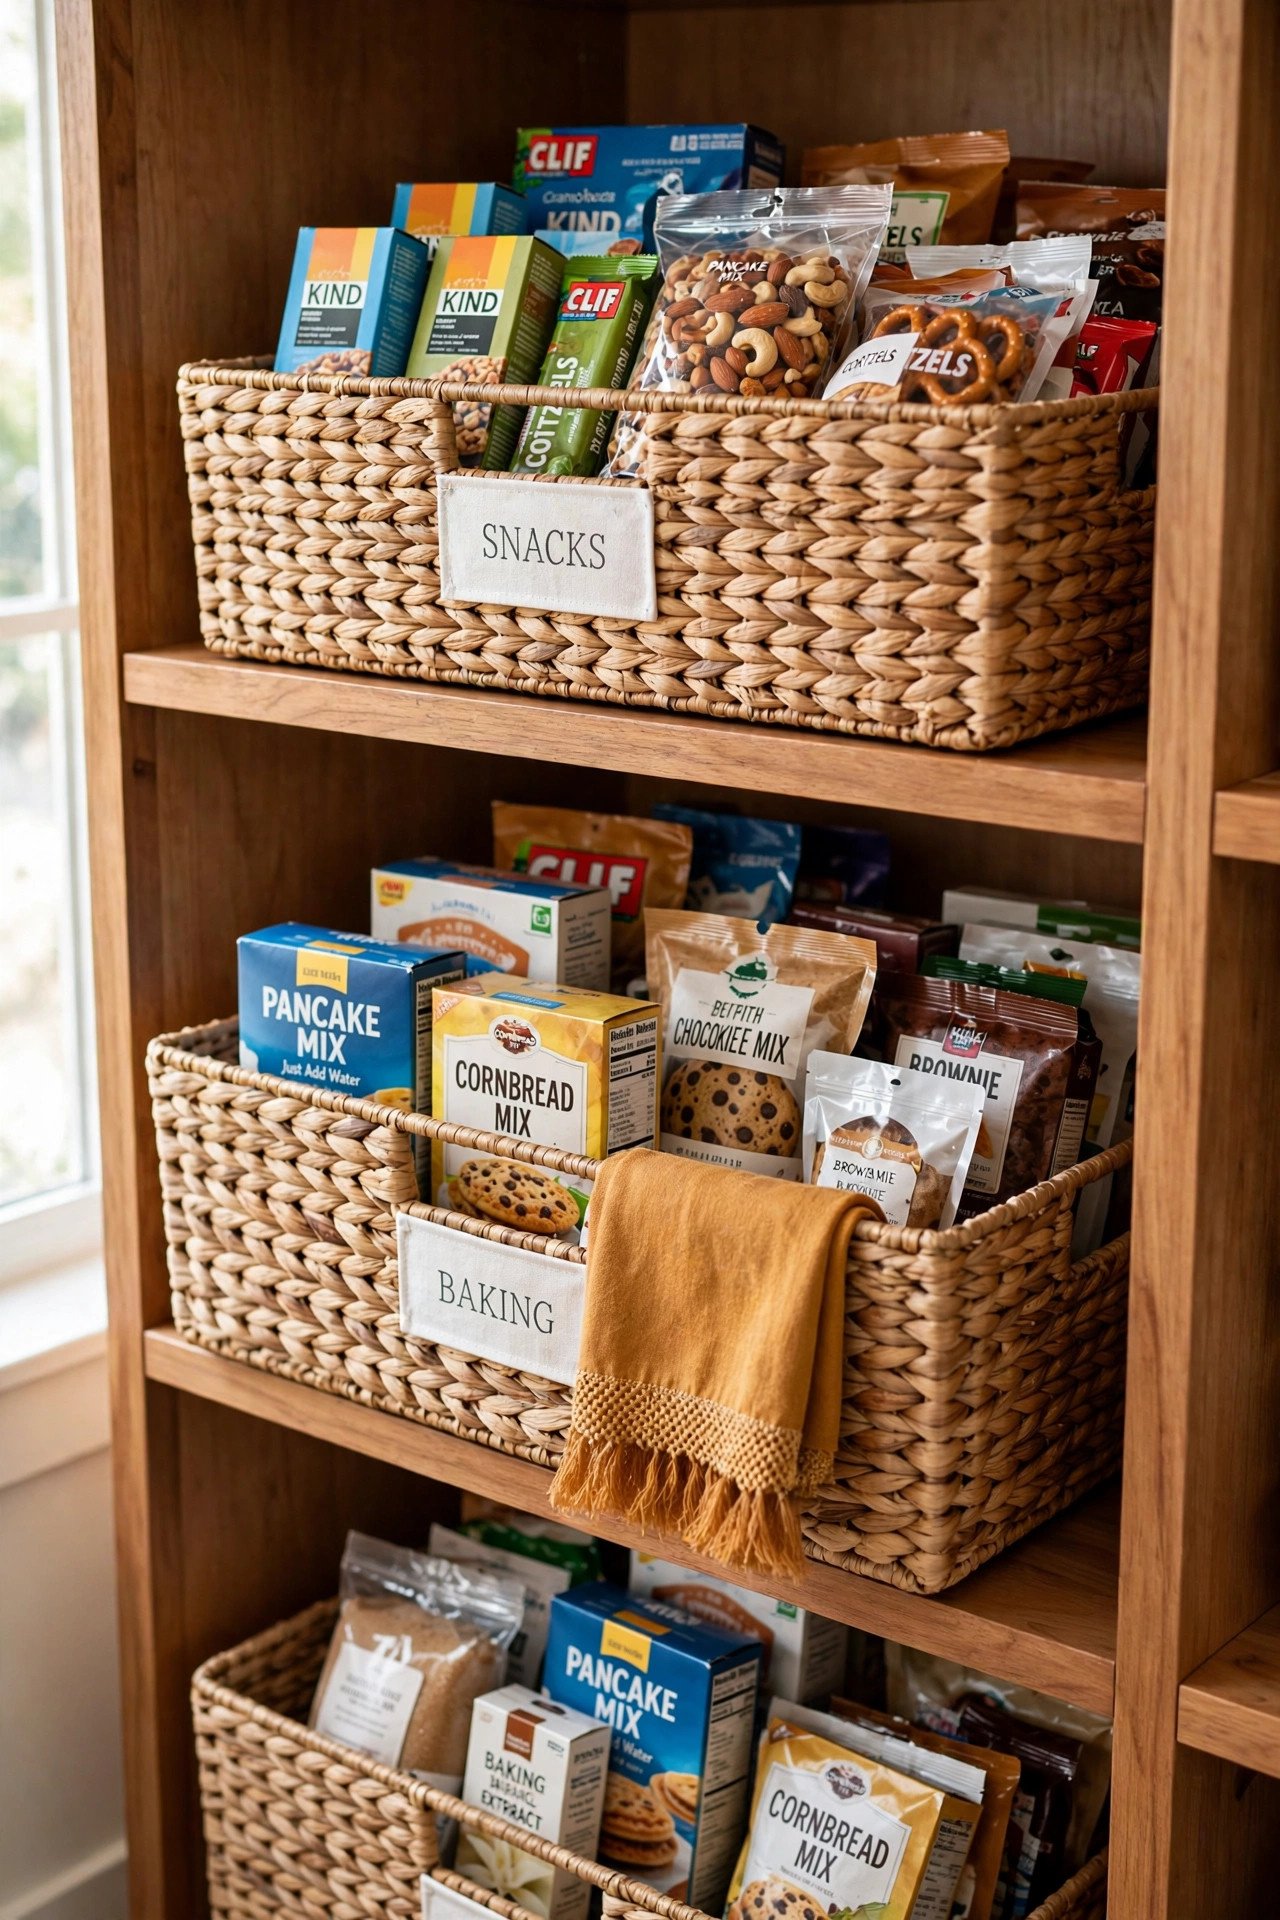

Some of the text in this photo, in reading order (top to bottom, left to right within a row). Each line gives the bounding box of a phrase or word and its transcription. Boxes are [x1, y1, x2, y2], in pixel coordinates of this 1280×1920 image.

[528, 141, 592, 171] CLIF
[706, 260, 769, 273] PANCAKE
[718, 271, 747, 283] MIX
[307, 283, 363, 305] KIND
[442, 291, 498, 313] KIND
[566, 287, 620, 313] CLIF
[482, 523, 606, 569] SNACKS
[262, 985, 381, 1038] PANCAKE
[296, 1026, 347, 1065] MIX
[752, 1030, 790, 1065] MIX
[280, 1059, 361, 1086] Just Add Water
[455, 1059, 575, 1112] CORNBREAD
[494, 1103, 532, 1138] MIX
[437, 1269, 555, 1335] BAKING
[566, 1645, 678, 1723] PANCAKE
[594, 1693, 643, 1740] MIX
[484, 1751, 546, 1794] BAKING
[768, 1789, 890, 1869] CORNBREAD
[794, 1839, 838, 1883] MIX
